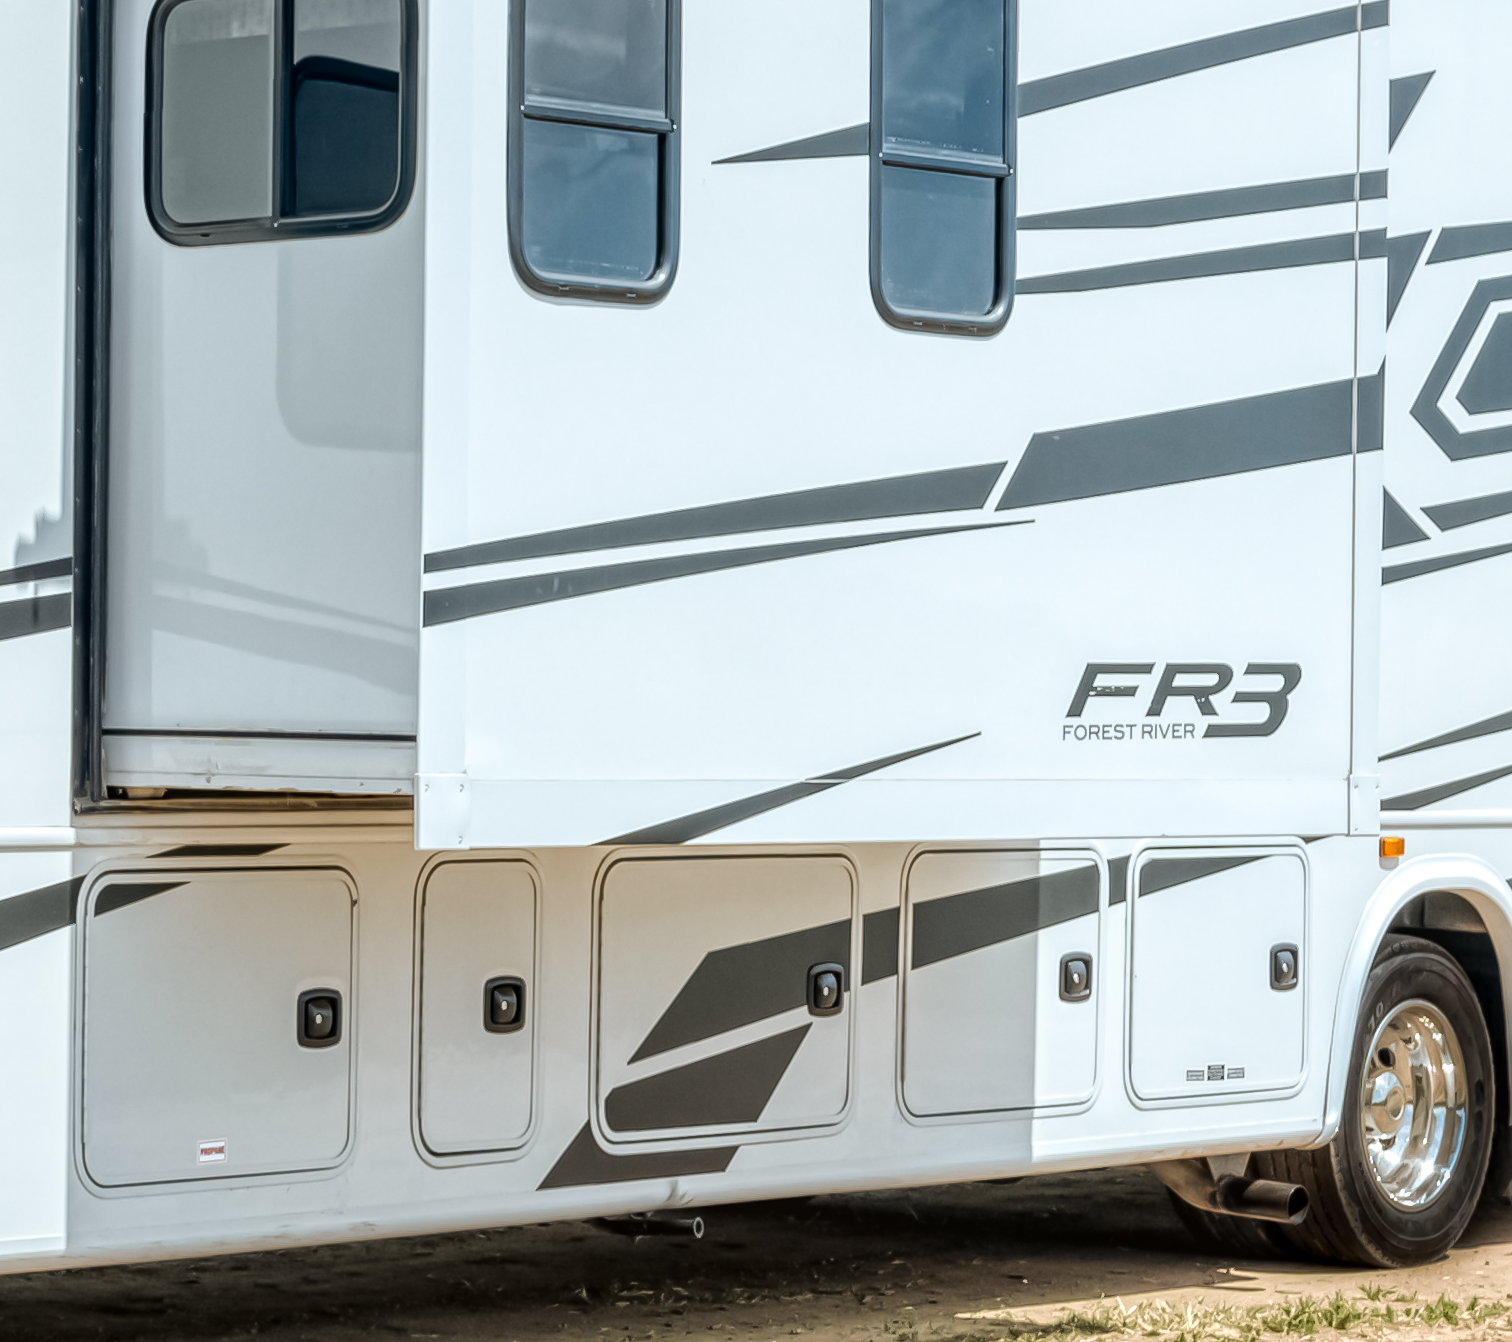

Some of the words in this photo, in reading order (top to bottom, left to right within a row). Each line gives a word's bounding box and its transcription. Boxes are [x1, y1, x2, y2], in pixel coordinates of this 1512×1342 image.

[1065, 661, 1302, 739] FR3
[1062, 723, 1137, 741] FOREST
[1141, 723, 1196, 740] RIVER
